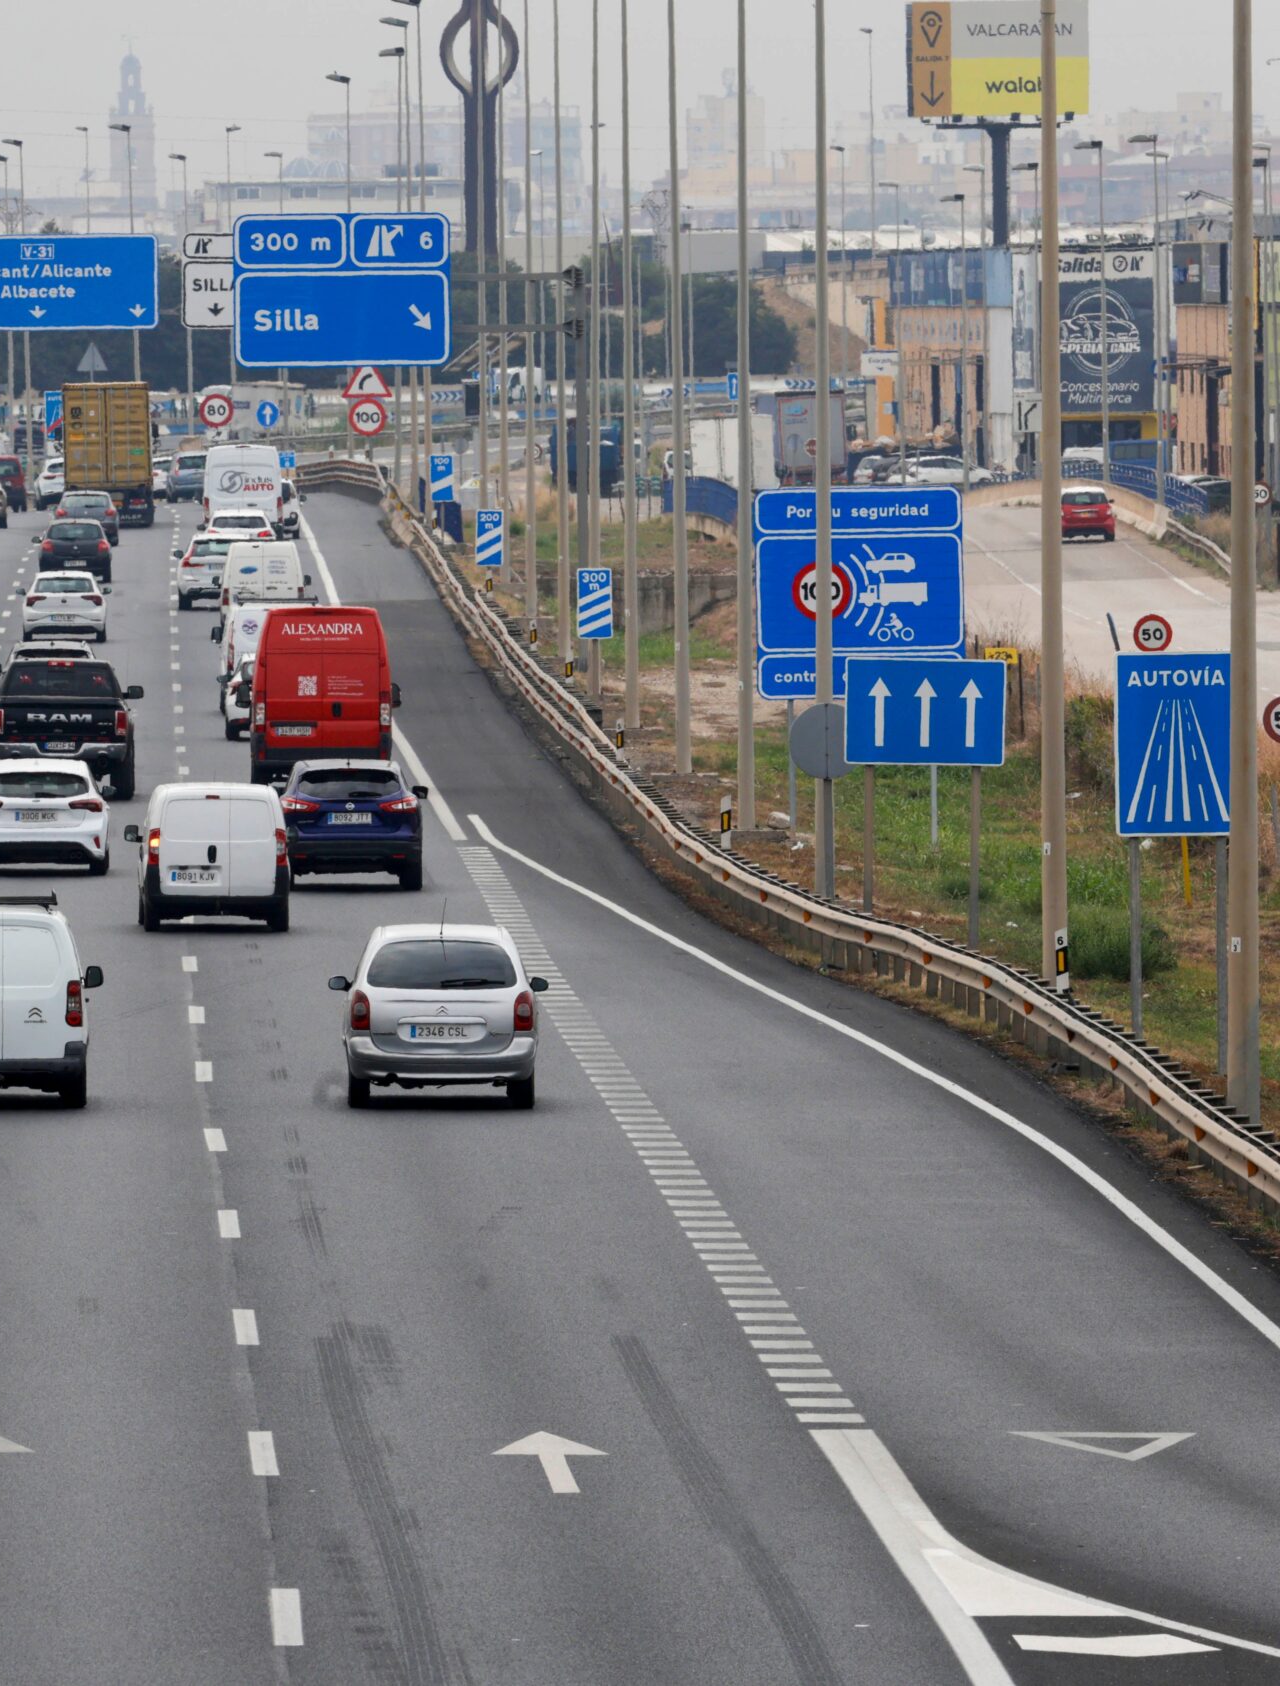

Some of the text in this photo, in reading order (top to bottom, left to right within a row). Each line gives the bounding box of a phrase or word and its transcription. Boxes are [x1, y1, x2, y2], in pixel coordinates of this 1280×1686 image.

[967, 22, 1072, 37] VALCARAAN
[250, 232, 332, 252] 300 m
[419, 231, 433, 250] 6
[23, 245, 53, 258] V-31
[0, 285, 76, 299] Albacete
[254, 308, 320, 331] Silla
[1059, 380, 1140, 392] Concesonario
[207, 404, 226, 417] 80
[355, 411, 380, 424] 100
[434, 457, 449, 465] 100
[243, 483, 274, 491] AUTO
[480, 513, 500, 522] 200
[786, 505, 812, 518] Por
[851, 504, 929, 519] seguridad
[582, 572, 607, 583] 300
[589, 583, 600, 591] m
[281, 623, 364, 635] ALEXANDRA
[1142, 628, 1164, 641] 50
[774, 669, 817, 683] contr
[1127, 666, 1226, 687] AUTOVÍA
[27, 713, 93, 722] RAM
[333, 813, 352, 823] 8092
[177, 871, 215, 881] 8091 KJV
[1057, 936, 1064, 946] 6
[418, 1027, 467, 1037] 2346 CSL
